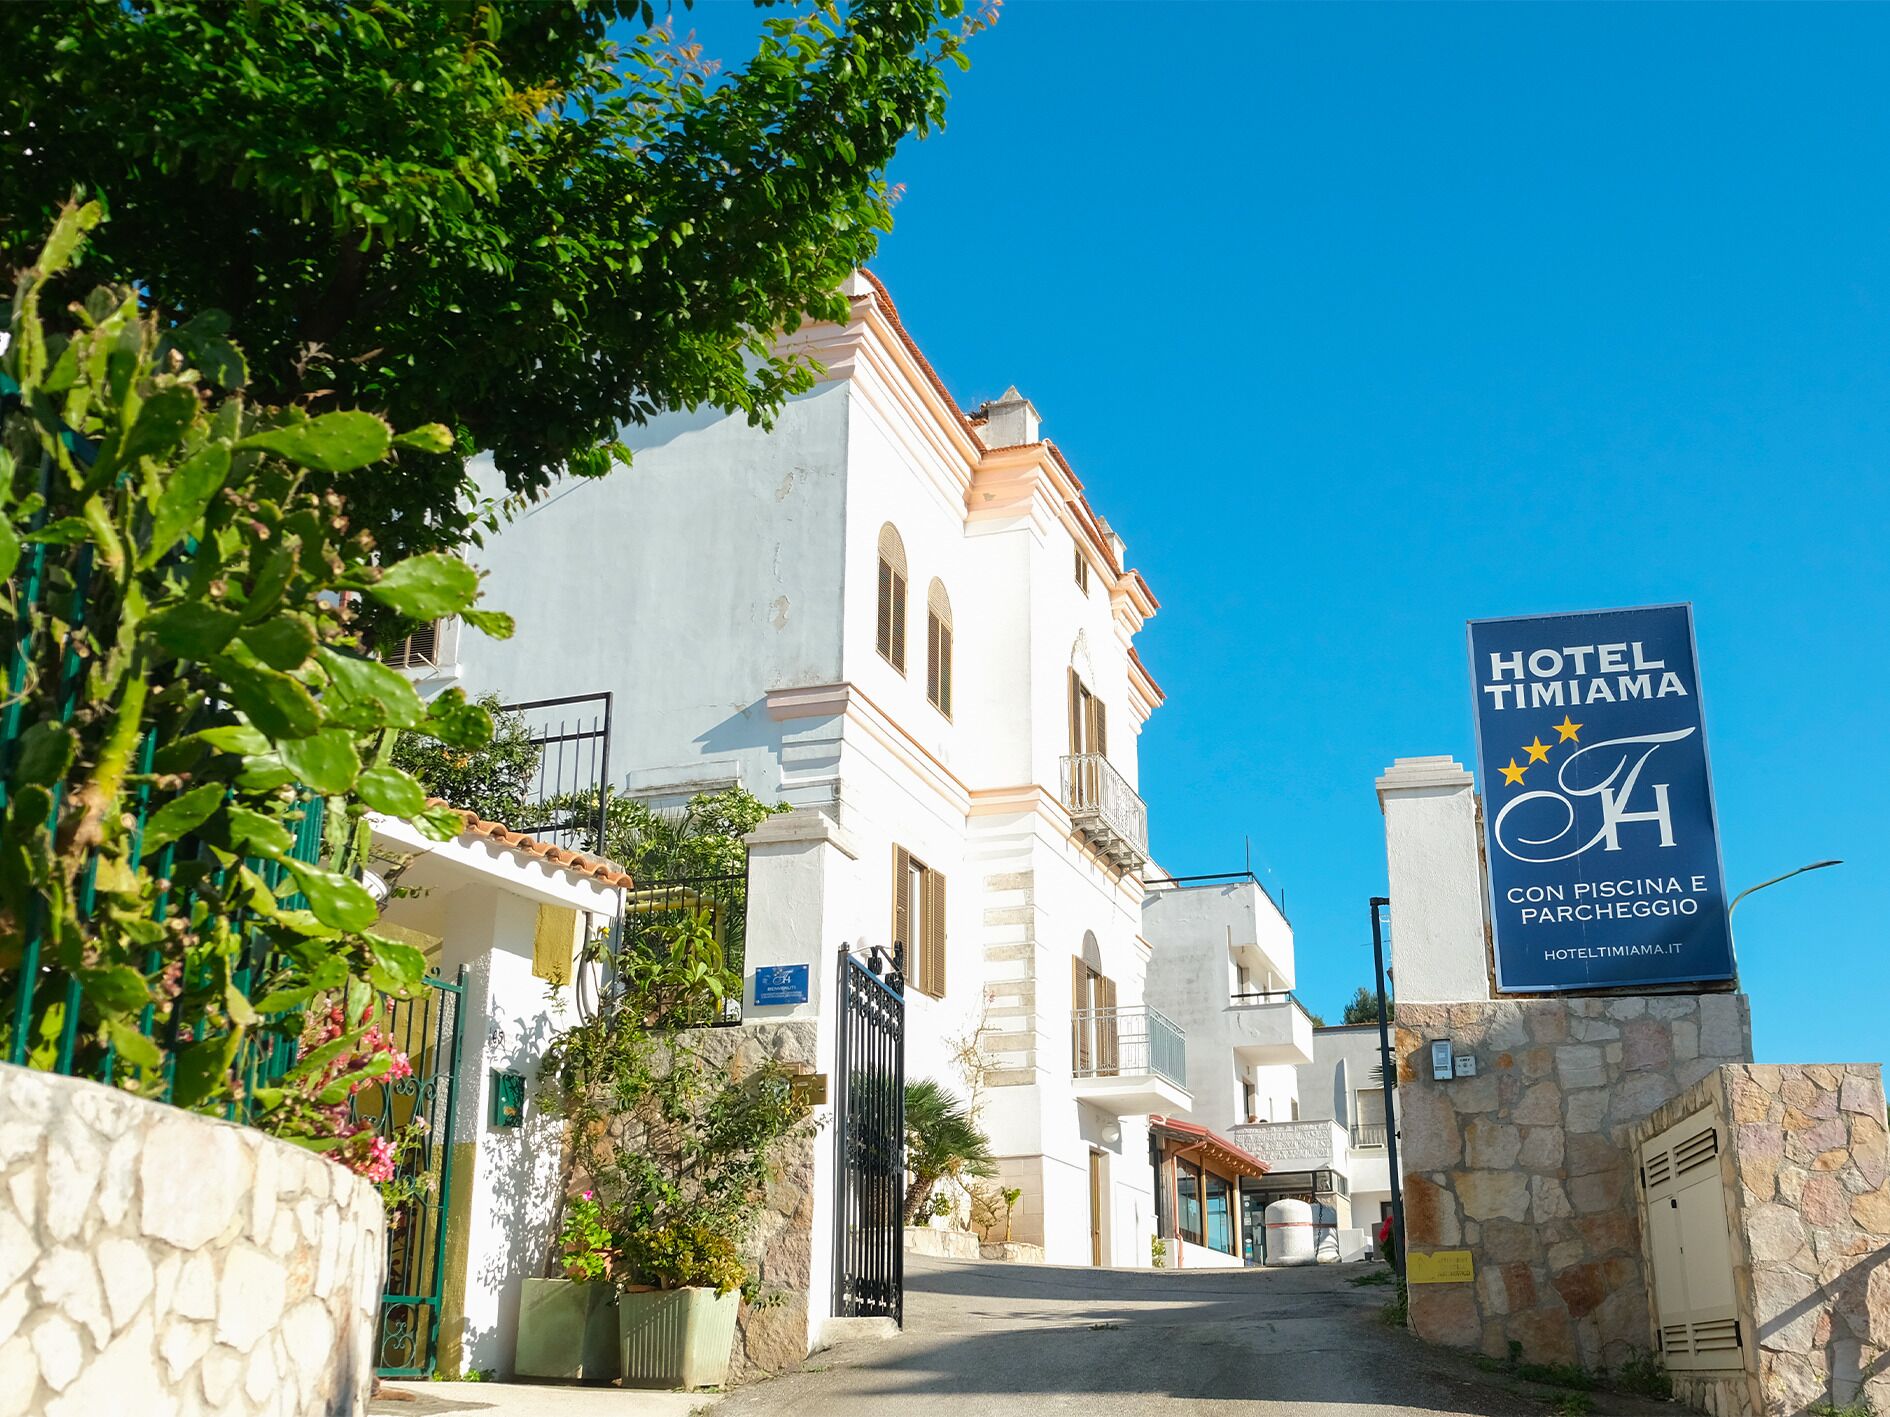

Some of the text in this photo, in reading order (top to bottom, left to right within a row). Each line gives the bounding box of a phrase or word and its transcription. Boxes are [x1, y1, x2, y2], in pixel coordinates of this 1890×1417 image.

[1490, 642, 1665, 680] HOTEL
[1484, 672, 1688, 710] TIMIAMA
[1507, 875, 1707, 903] CON PISCINA E
[1521, 898, 1698, 924] PARCHEGGIO
[1544, 943, 1683, 960] HOTELTIMIAMA.IT
